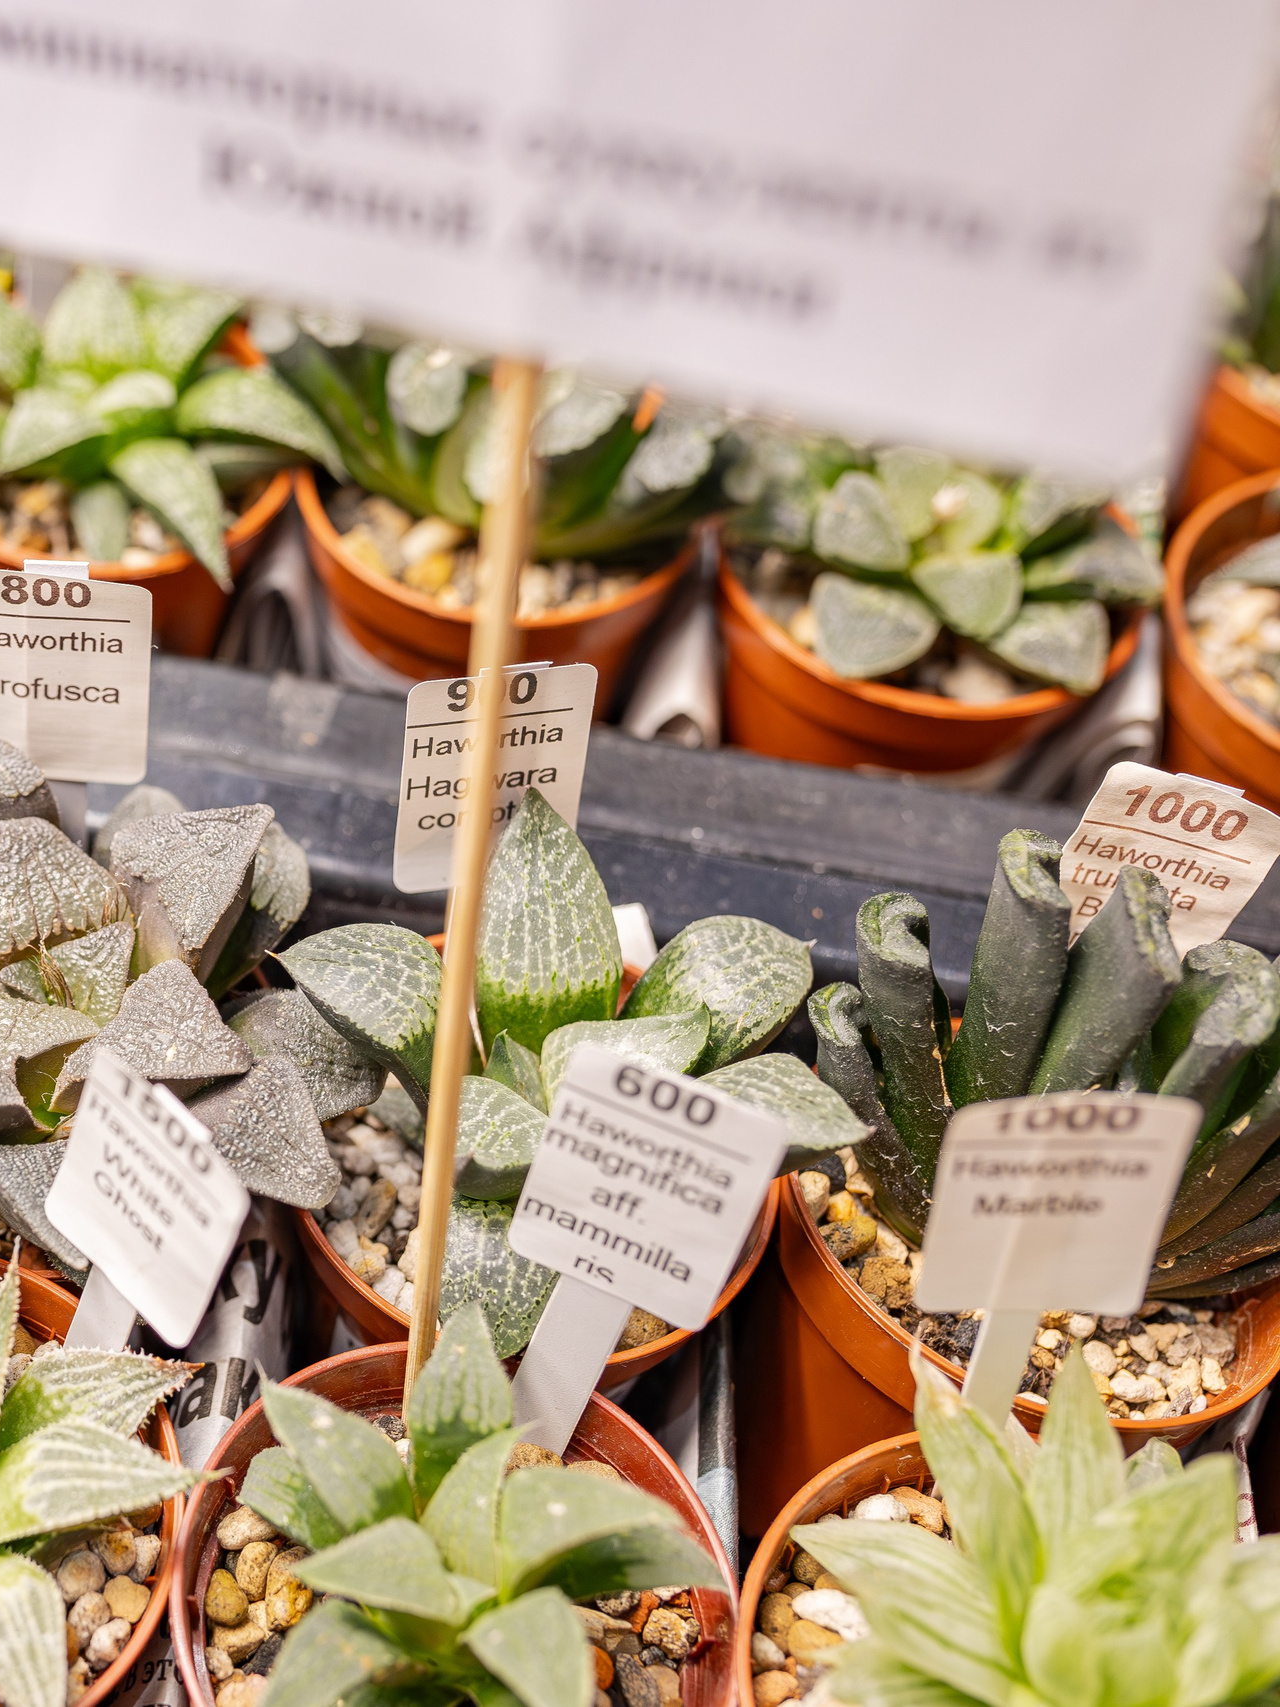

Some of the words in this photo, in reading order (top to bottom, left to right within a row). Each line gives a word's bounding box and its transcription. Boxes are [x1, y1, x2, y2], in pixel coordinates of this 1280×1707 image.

[1, 575, 91, 608] 800
[447, 672, 538, 712] 90
[412, 724, 563, 759] Hawrthia
[407, 767, 557, 801] Hagwara
[1124, 785, 1249, 841] 1000
[1071, 862, 1197, 912] truta
[1073, 834, 1231, 891] Haworthia
[615, 1064, 716, 1127] 600
[546, 1127, 723, 1216] magnifica
[561, 1101, 733, 1190] Haworthia
[94, 1170, 164, 1254] Ghost
[591, 1185, 646, 1225] aff.
[523, 1195, 692, 1282] mammilla
